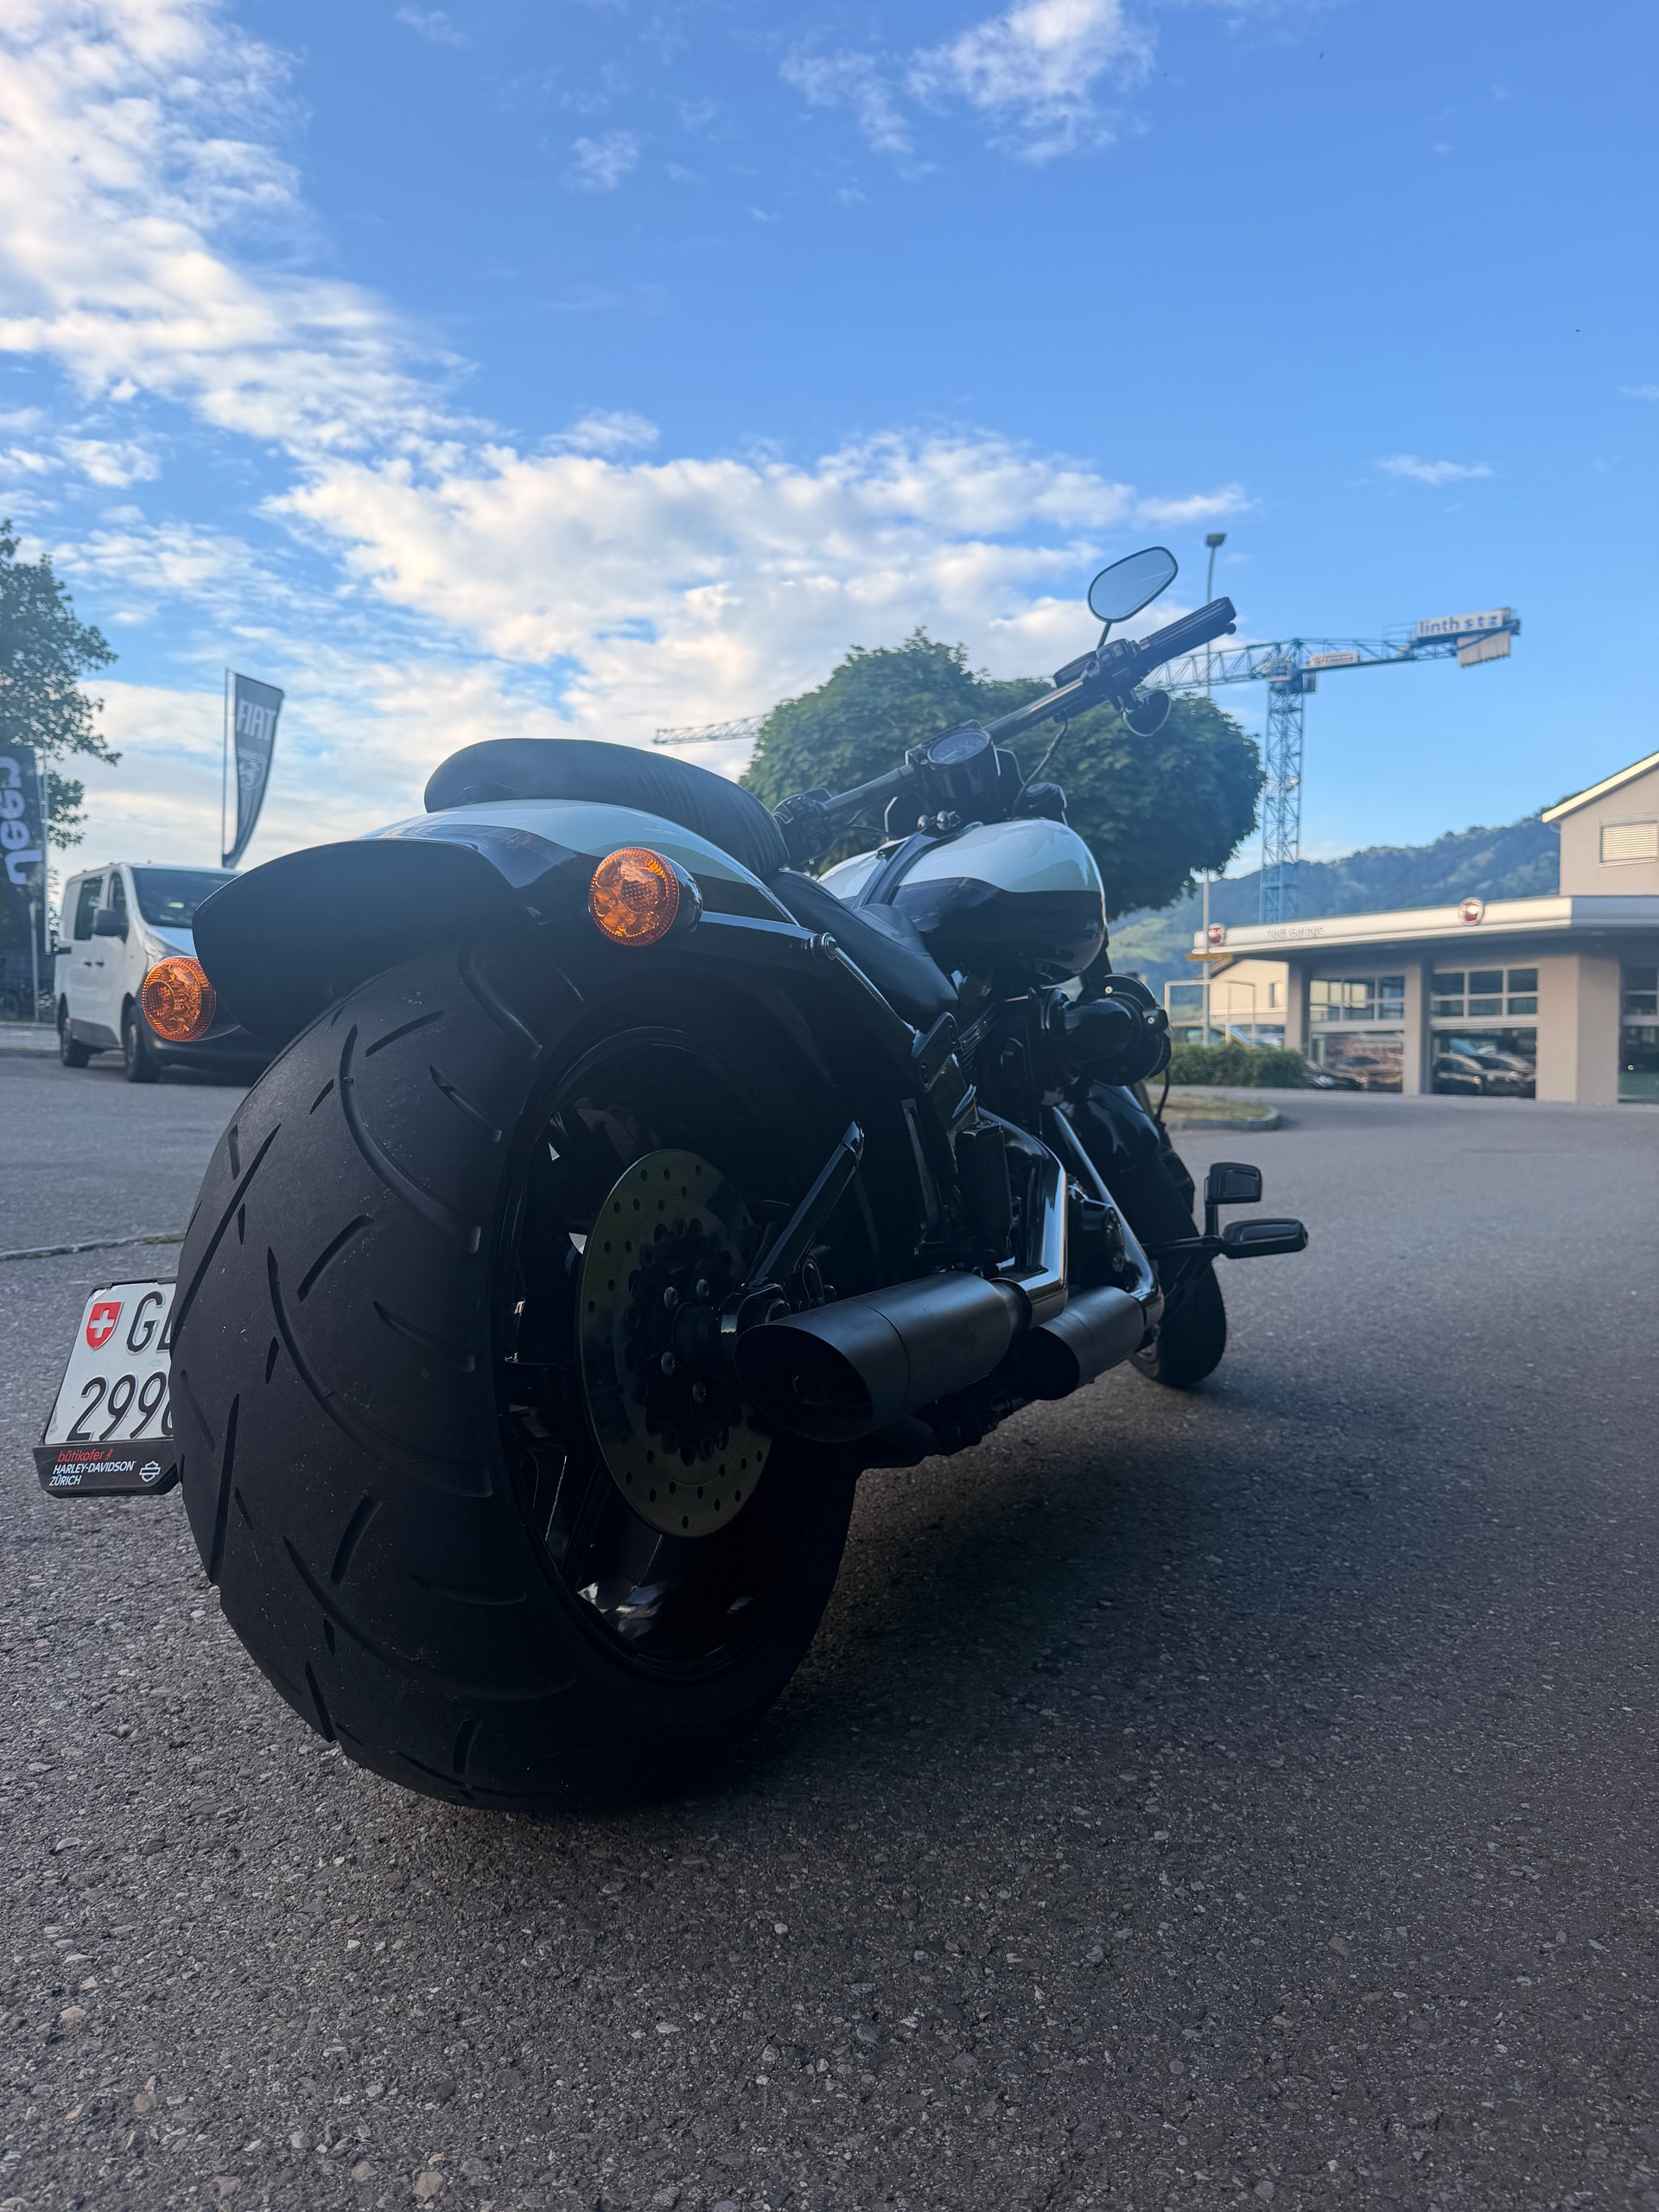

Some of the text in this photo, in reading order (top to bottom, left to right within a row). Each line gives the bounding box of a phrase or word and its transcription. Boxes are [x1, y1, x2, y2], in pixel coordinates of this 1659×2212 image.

[236, 698, 277, 741] FIAT
[56, 1449, 105, 1463] bütikofer
[53, 1461, 135, 1475] HARLEY-DAVIDSON
[48, 1474, 82, 1486] ZÜRICH
